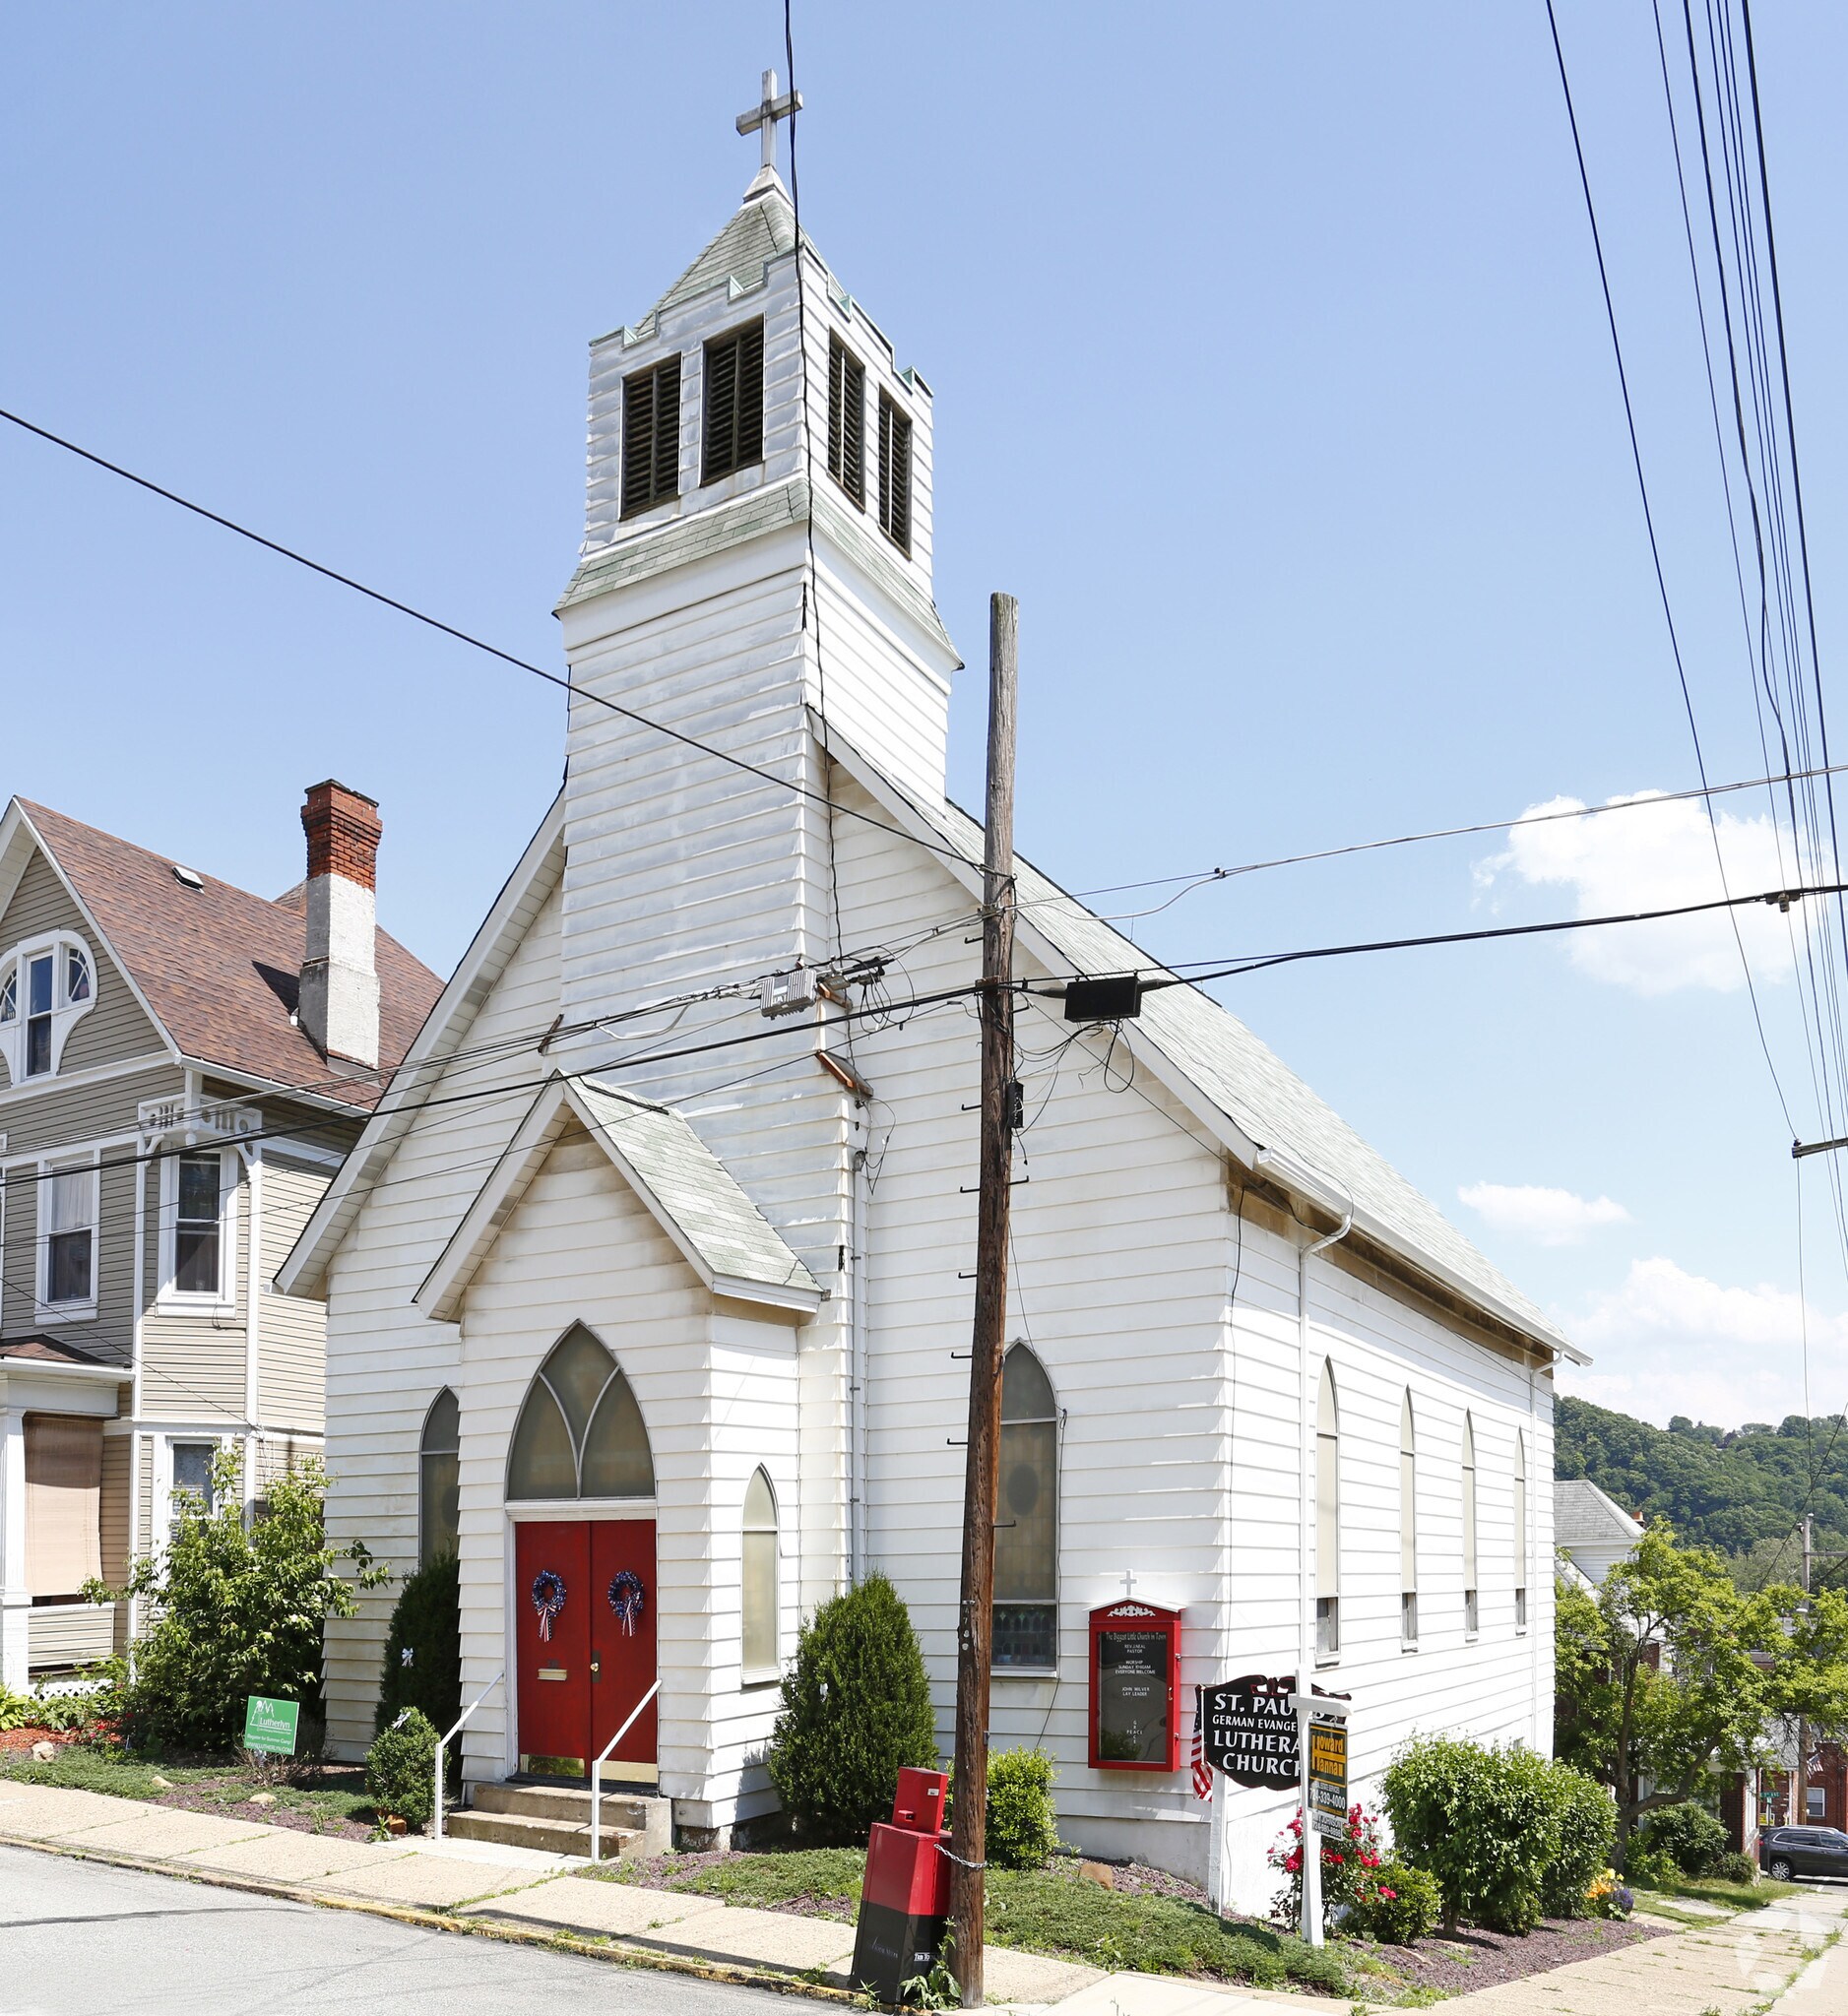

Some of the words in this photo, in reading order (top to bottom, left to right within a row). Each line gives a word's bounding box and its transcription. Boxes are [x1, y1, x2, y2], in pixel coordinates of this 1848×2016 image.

[1213, 1693, 1245, 1712] ST.
[260, 1718, 290, 1730] Lutherlyn
[1212, 1714, 1255, 1728] GERMAN
[1257, 1718, 1298, 1732] EVANGE
[1213, 1730, 1301, 1754] LUTHERA
